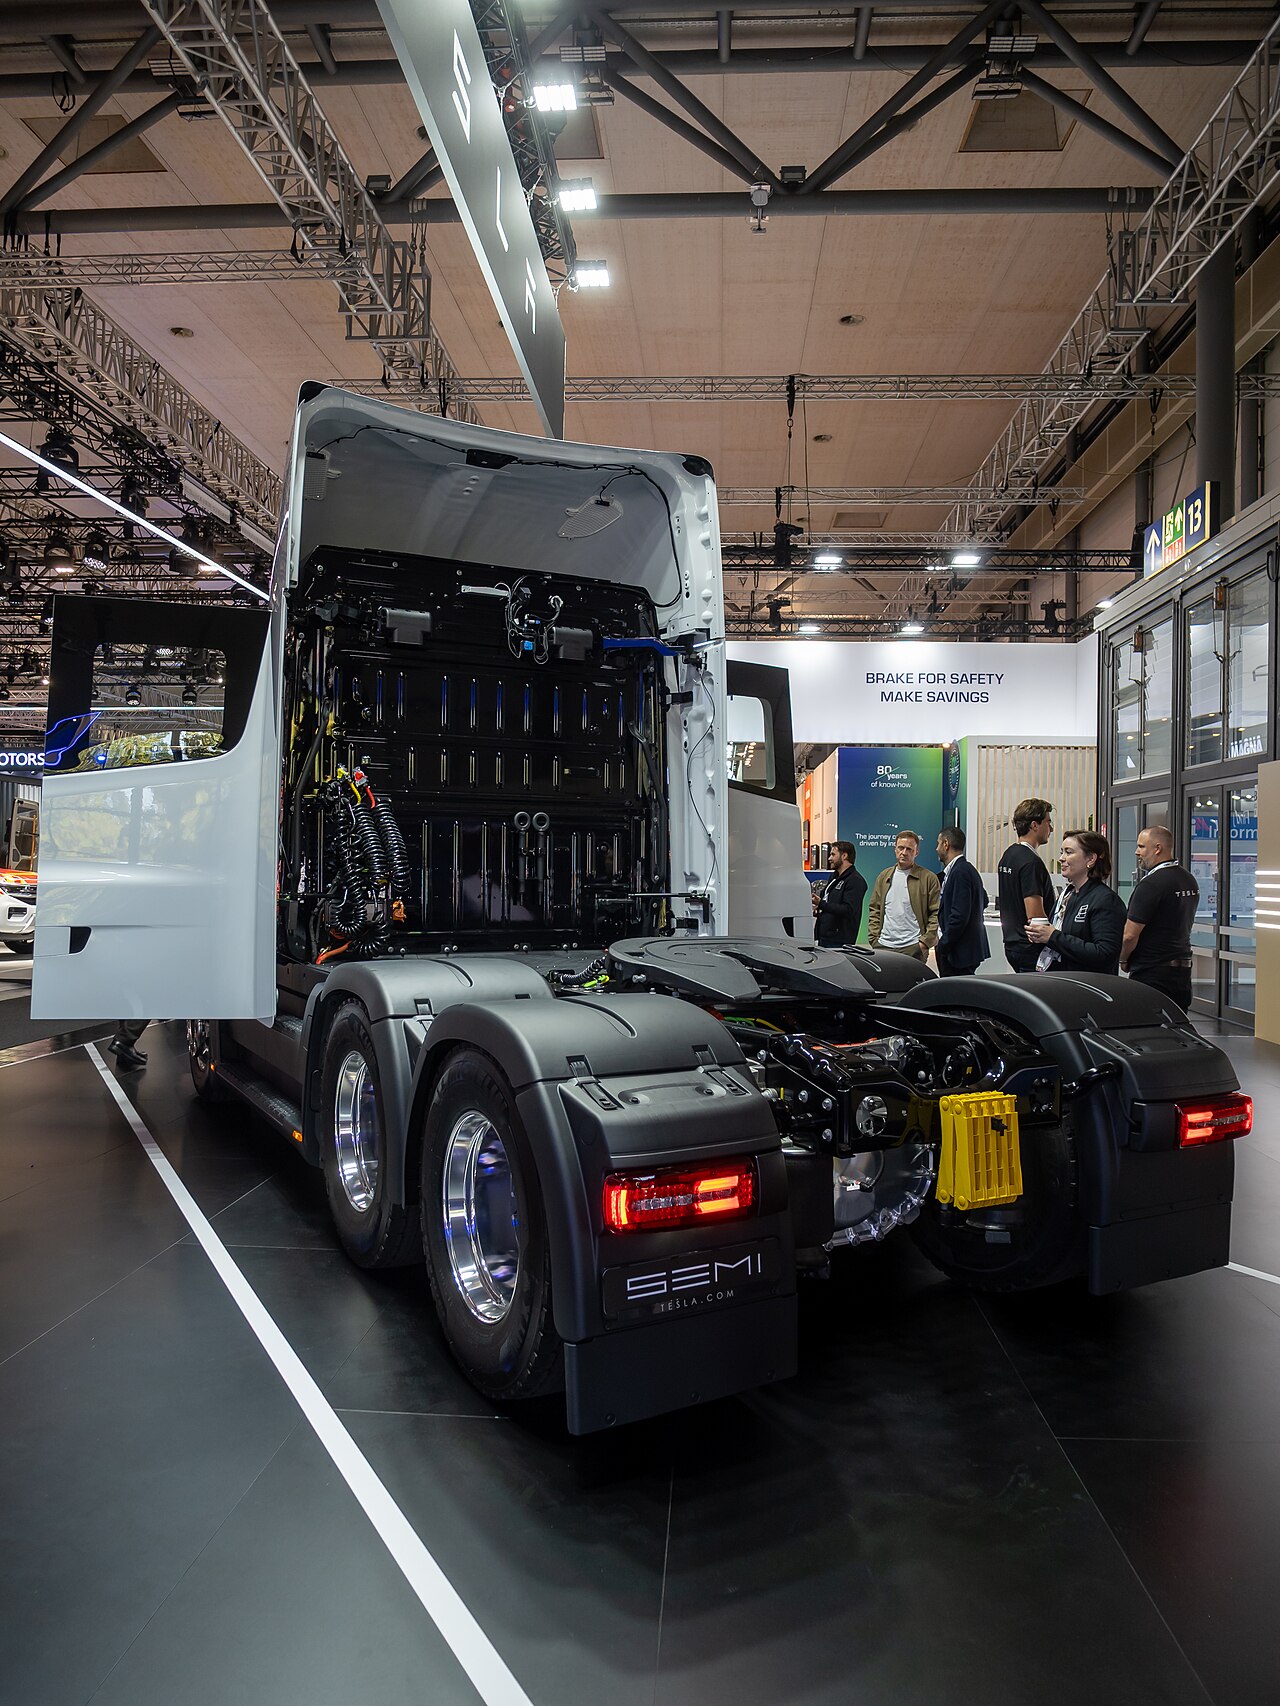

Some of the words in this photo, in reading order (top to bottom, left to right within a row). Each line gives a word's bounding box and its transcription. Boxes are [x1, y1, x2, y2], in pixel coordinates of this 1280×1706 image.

[1187, 498, 1202, 536] 13
[865, 672, 914, 684] BRAKE
[918, 672, 946, 684] FOR
[950, 673, 1005, 685] SAFETY
[880, 691, 923, 703] MAKE
[926, 691, 990, 703] SAVINGS
[0, 752, 46, 766] OTORS
[876, 765, 892, 775] 80
[868, 833, 892, 841] journey
[626, 1252, 761, 1300] SEMI
[660, 1289, 735, 1312] TESLA.COM
